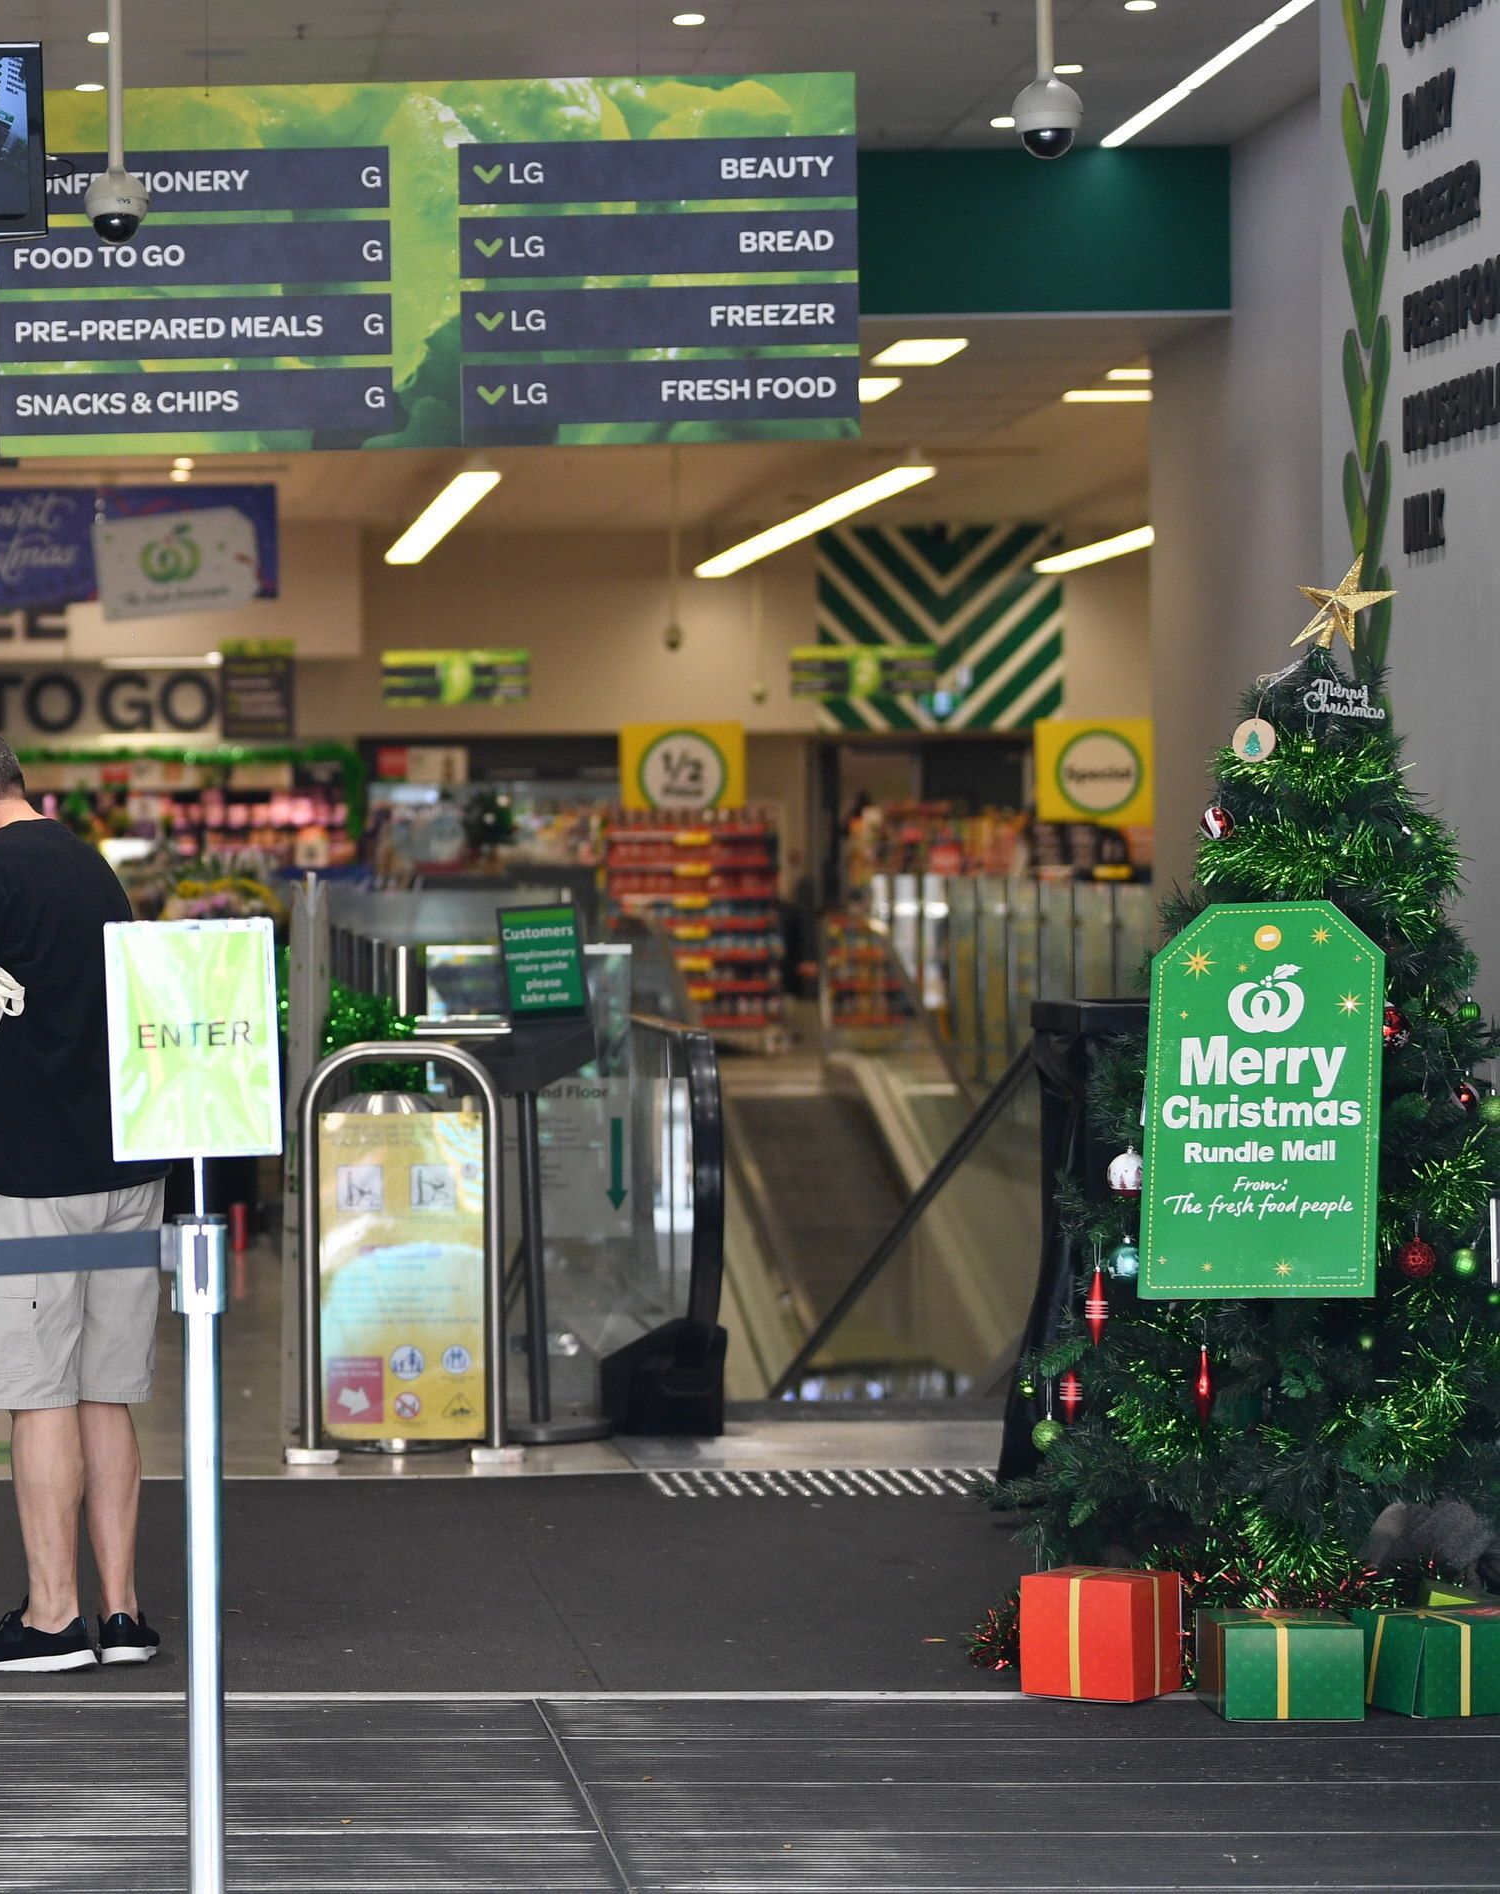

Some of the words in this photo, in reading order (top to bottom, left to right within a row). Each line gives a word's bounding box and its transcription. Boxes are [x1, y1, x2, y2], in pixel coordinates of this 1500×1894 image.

[361, 166, 382, 188] G
[508, 162, 545, 185] LG
[720, 155, 834, 180] BEAUTY
[1402, 160, 1481, 251] FREEZER
[13, 246, 93, 270] FOOD
[98, 245, 137, 268] TO
[142, 244, 186, 267] GO
[362, 239, 383, 262] G
[509, 235, 546, 258] LG
[738, 229, 834, 253] BREAD
[14, 316, 226, 344] PRE-PREPARED
[231, 314, 323, 338] MEALS
[362, 313, 384, 336] G
[510, 309, 547, 332] LG
[709, 302, 835, 328] FREEZER
[15, 392, 126, 417] SNACKS
[130, 391, 152, 415] &
[156, 389, 239, 413] CHIPS
[364, 386, 386, 409] G
[512, 382, 549, 405] LG
[660, 377, 751, 402] FRESH
[755, 375, 838, 400] FOOD
[1402, 362, 1500, 454] HOUSEHOL
[98, 671, 216, 732] GO
[1303, 690, 1386, 720] Christmas
[1311, 678, 1368, 707] Merry
[502, 926, 574, 940] Customers
[521, 993, 546, 1004] take
[548, 991, 570, 1003] one
[525, 978, 562, 993] please
[137, 1020, 253, 1049] ENTER
[1179, 1035, 1347, 1098] Merry
[1162, 1094, 1362, 1130] Christmas
[1184, 1140, 1275, 1164] Rundle
[1281, 1140, 1336, 1162] Mall
[1232, 1175, 1289, 1193] From:
[1163, 1191, 1203, 1215] The
[1207, 1194, 1255, 1222] fresh
[1257, 1193, 1300, 1221] food
[1299, 1195, 1354, 1221] people
